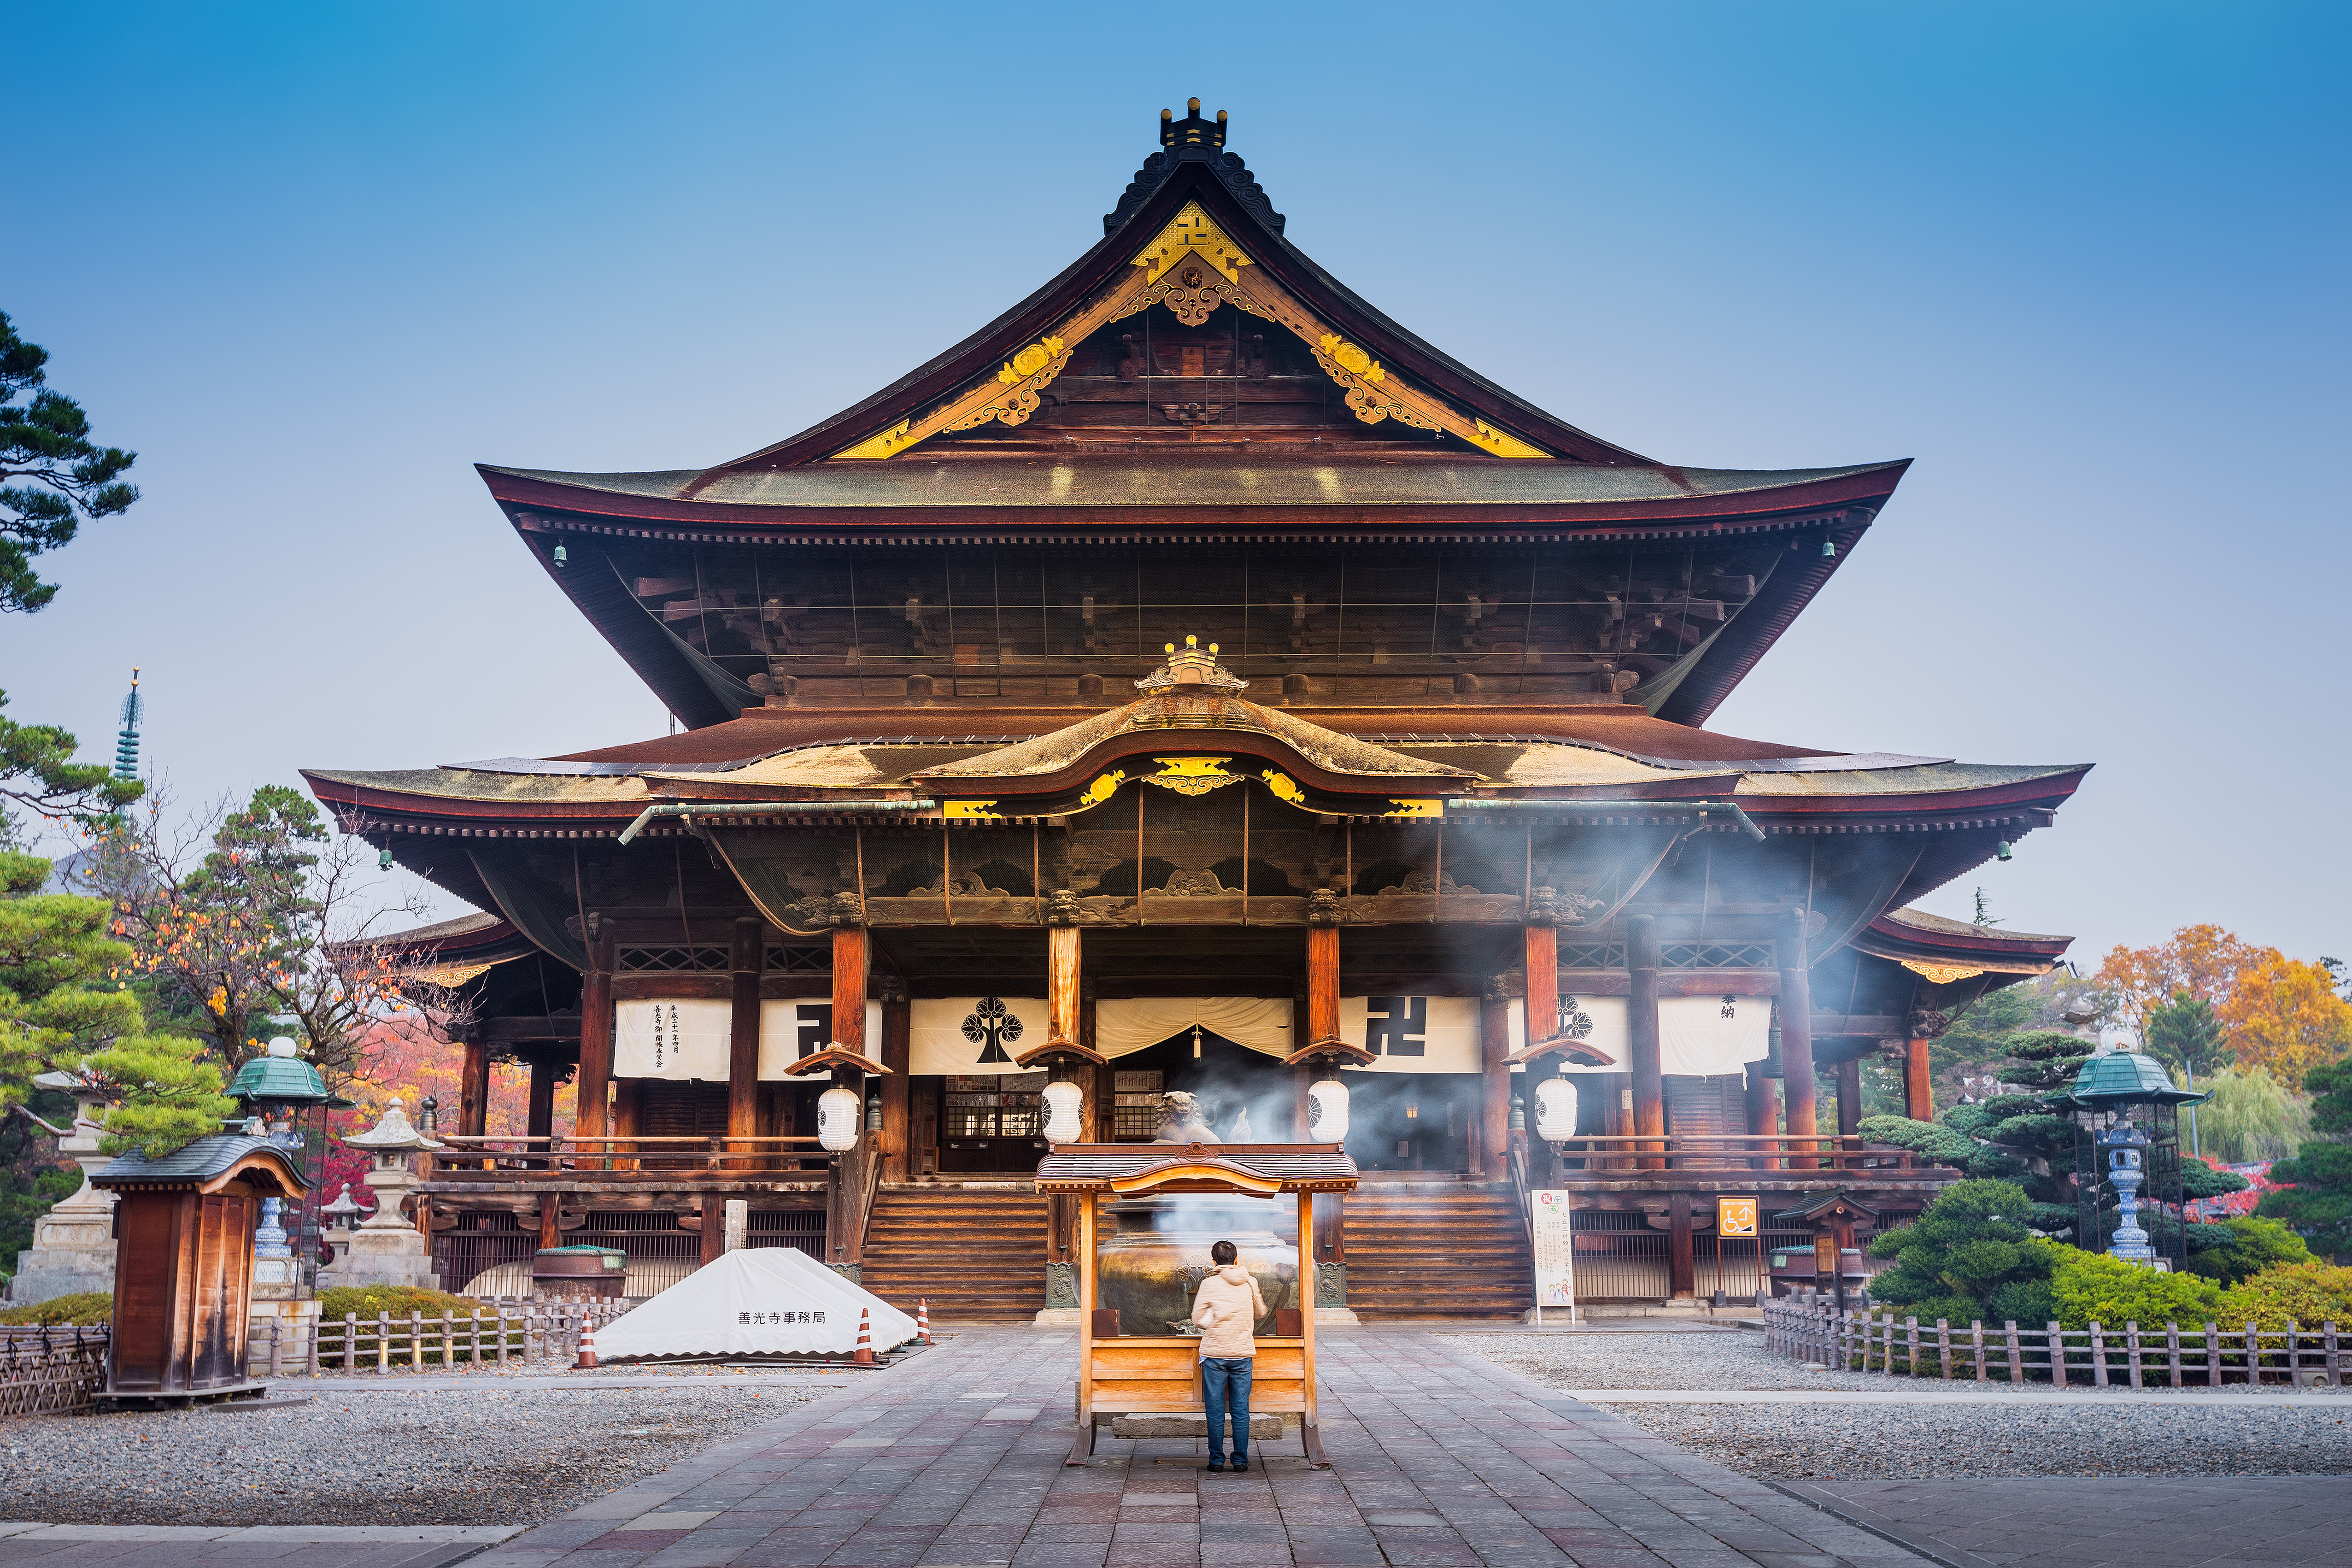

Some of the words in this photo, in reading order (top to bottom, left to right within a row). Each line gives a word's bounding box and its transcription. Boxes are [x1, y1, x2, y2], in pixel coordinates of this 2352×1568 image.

[1721, 994, 1736, 1019] 奉納
[654, 1004, 663, 1068] 善光寺御開帳奉賛会
[670, 1004, 679, 1054] 平成二十一年四月
[1542, 1194, 1551, 1203] 祝
[1561, 1212, 1570, 1275] 七五三祈願のご案内
[738, 1311, 825, 1325] 善光寺事務局
